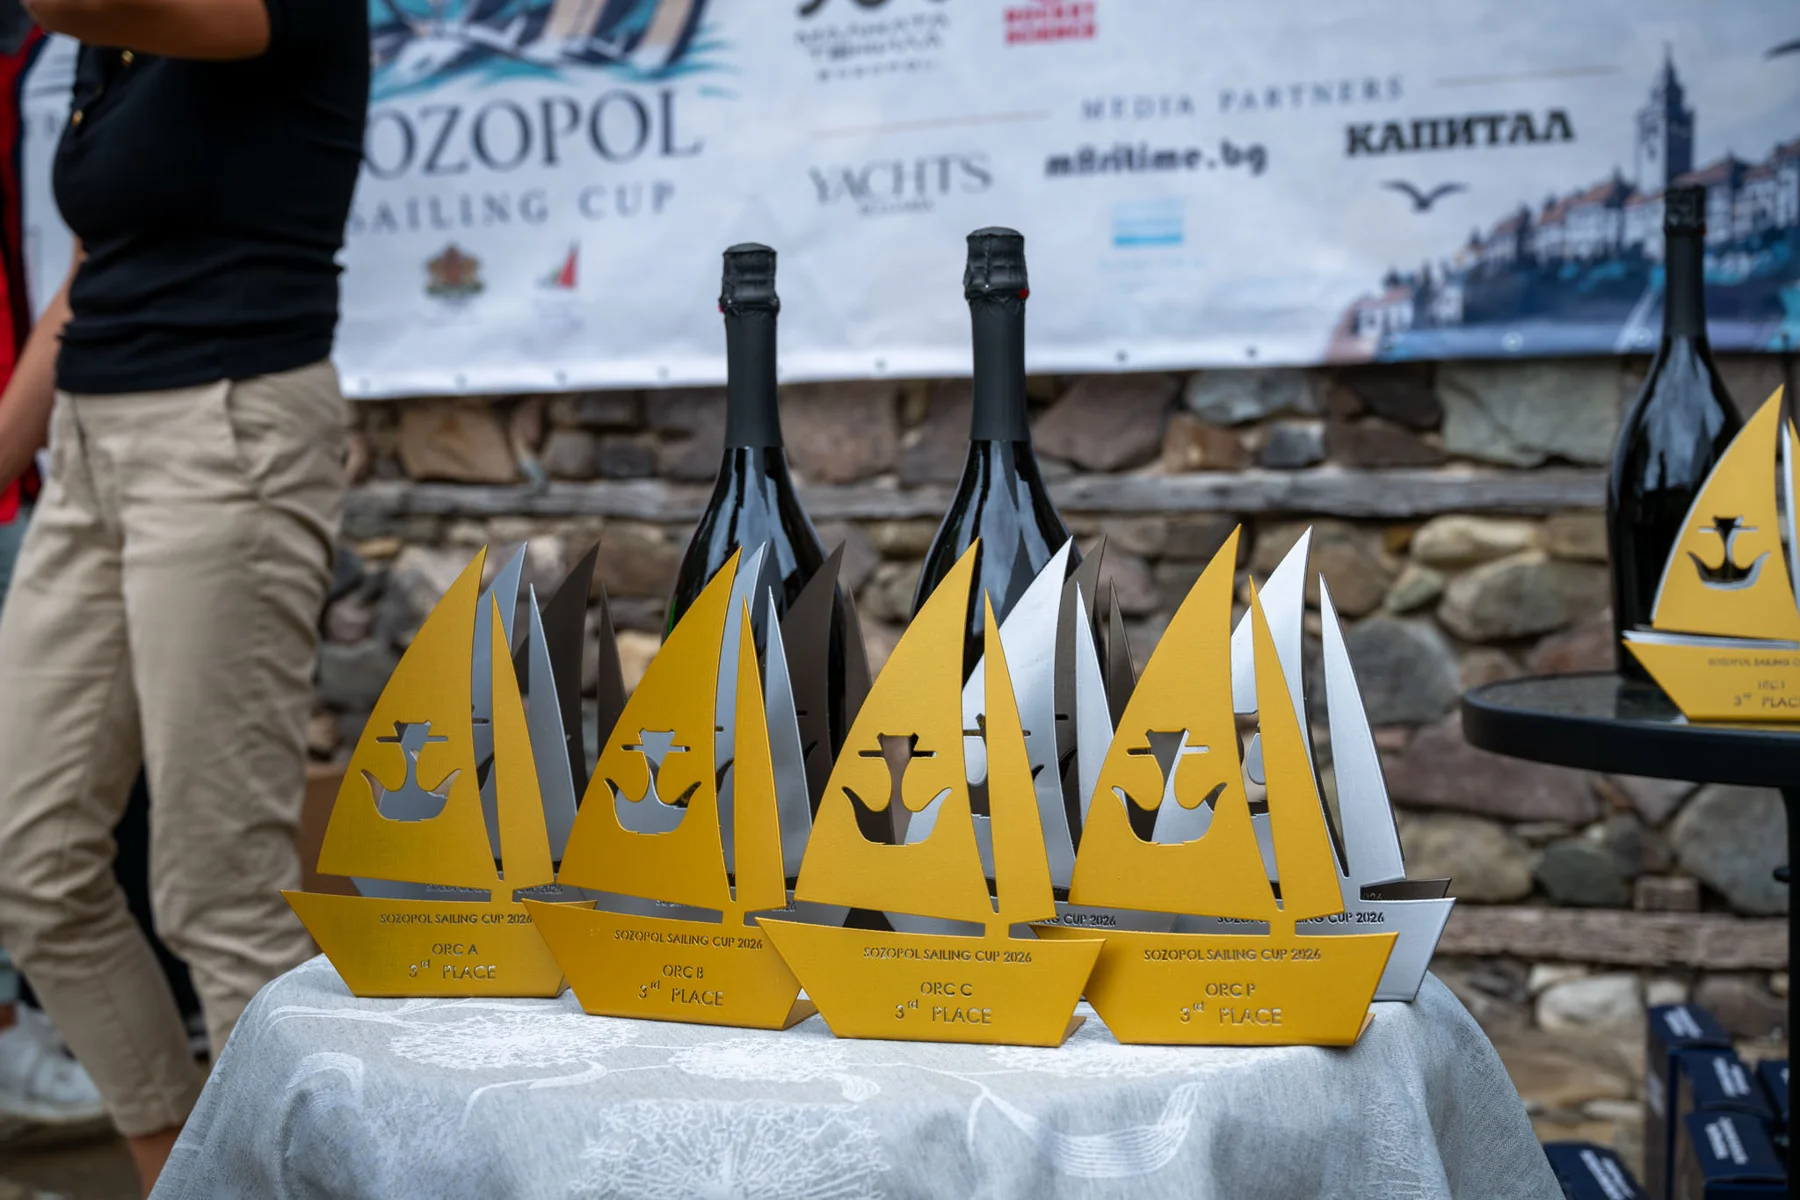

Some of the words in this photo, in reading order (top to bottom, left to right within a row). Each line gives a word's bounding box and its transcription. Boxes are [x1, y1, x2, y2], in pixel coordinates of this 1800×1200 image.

[1080, 96, 1196, 120] MEDIA
[1217, 75, 1405, 113] PARTNERS
[363, 87, 704, 181] OZOPOL
[1346, 108, 1576, 157] КАПИТАЛ
[808, 151, 993, 206] YACHTS
[577, 179, 676, 221] CUP
[1761, 695, 1800, 709] PLAC
[380, 914, 432, 925] SOZOPOL
[435, 914, 478, 925] SAILING
[481, 914, 504, 925] CUP
[507, 914, 533, 925] 2026
[1063, 912, 1087, 926] CUP
[1089, 914, 1116, 927] 2026
[1327, 912, 1353, 925] CUP
[1356, 911, 1385, 924] 2026
[614, 929, 665, 943] SOZOPOL
[667, 932, 709, 947] SAILING
[712, 935, 735, 949] CUP
[737, 938, 763, 950] 2026
[431, 943, 463, 956] ORC
[467, 943, 479, 956] A
[863, 946, 921, 960] SOZOPOL
[923, 948, 971, 961] SAILING
[975, 949, 1001, 962] CUP
[1003, 951, 1032, 963] 2026
[1143, 949, 1204, 961] SOZOPOL
[1206, 949, 1257, 961] SAILING
[1261, 948, 1288, 961] CUP
[1291, 948, 1322, 961] 2026
[442, 965, 497, 980] PLACE
[662, 964, 693, 979] ORC
[696, 966, 704, 980] B
[671, 987, 724, 1007] PLACE
[920, 981, 956, 997] ORC
[960, 983, 973, 997] C
[1205, 983, 1243, 997] ORC
[1246, 983, 1256, 997] P
[931, 1005, 993, 1025] PLACE
[1219, 1008, 1283, 1026] PLACE
